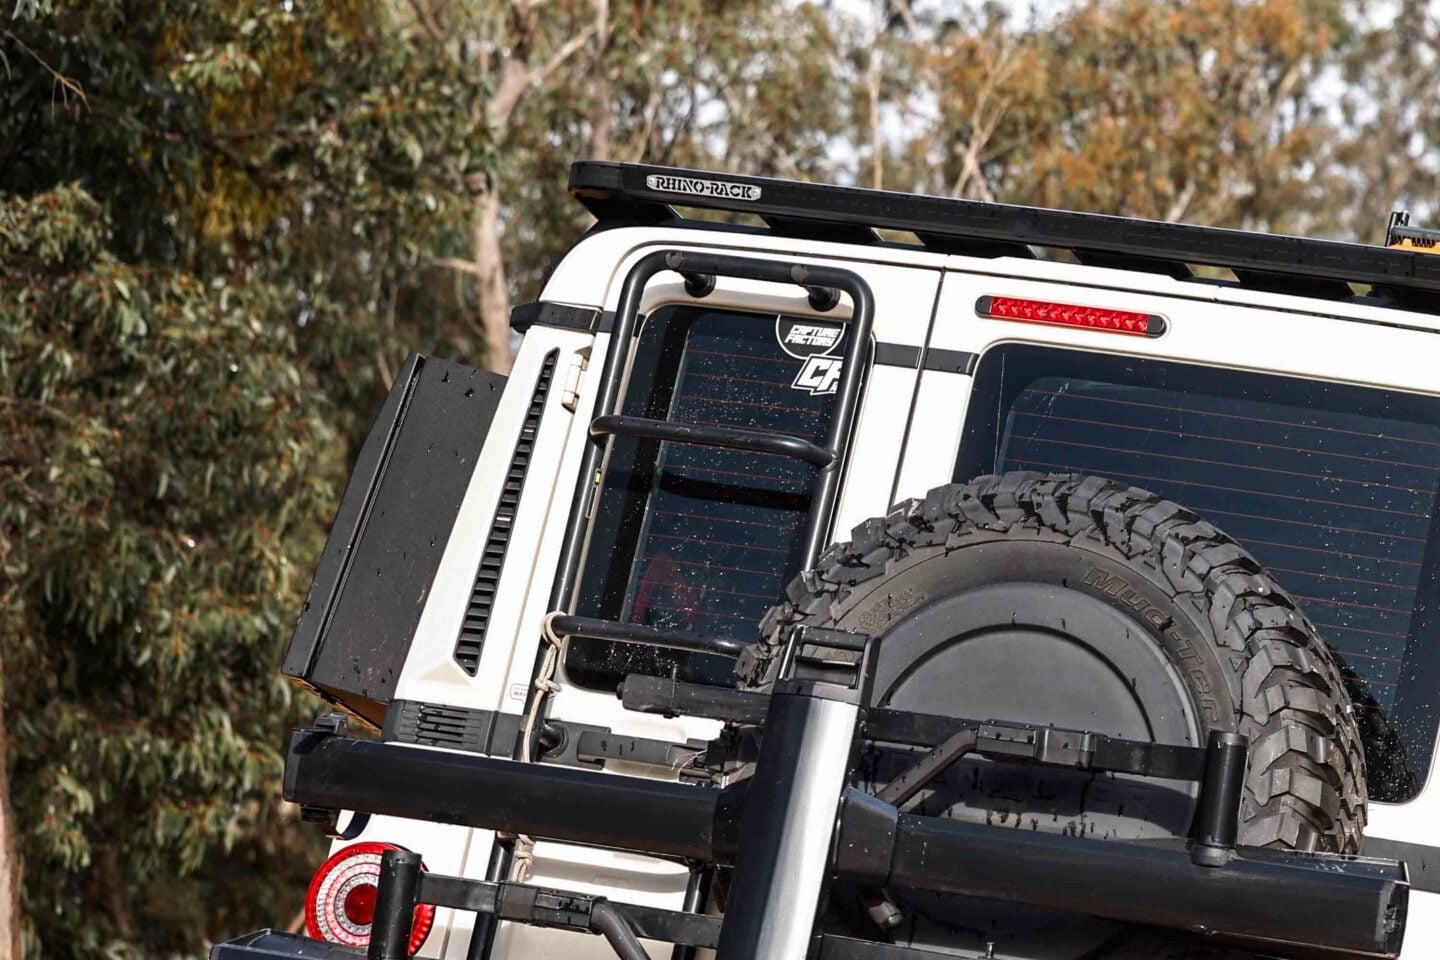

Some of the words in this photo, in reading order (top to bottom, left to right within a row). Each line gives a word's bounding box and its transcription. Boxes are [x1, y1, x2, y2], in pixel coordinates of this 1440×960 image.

[656, 176, 752, 198] RHINO-RACK
[790, 324, 841, 338] CAPTURE
[784, 333, 836, 347] FACTORY
